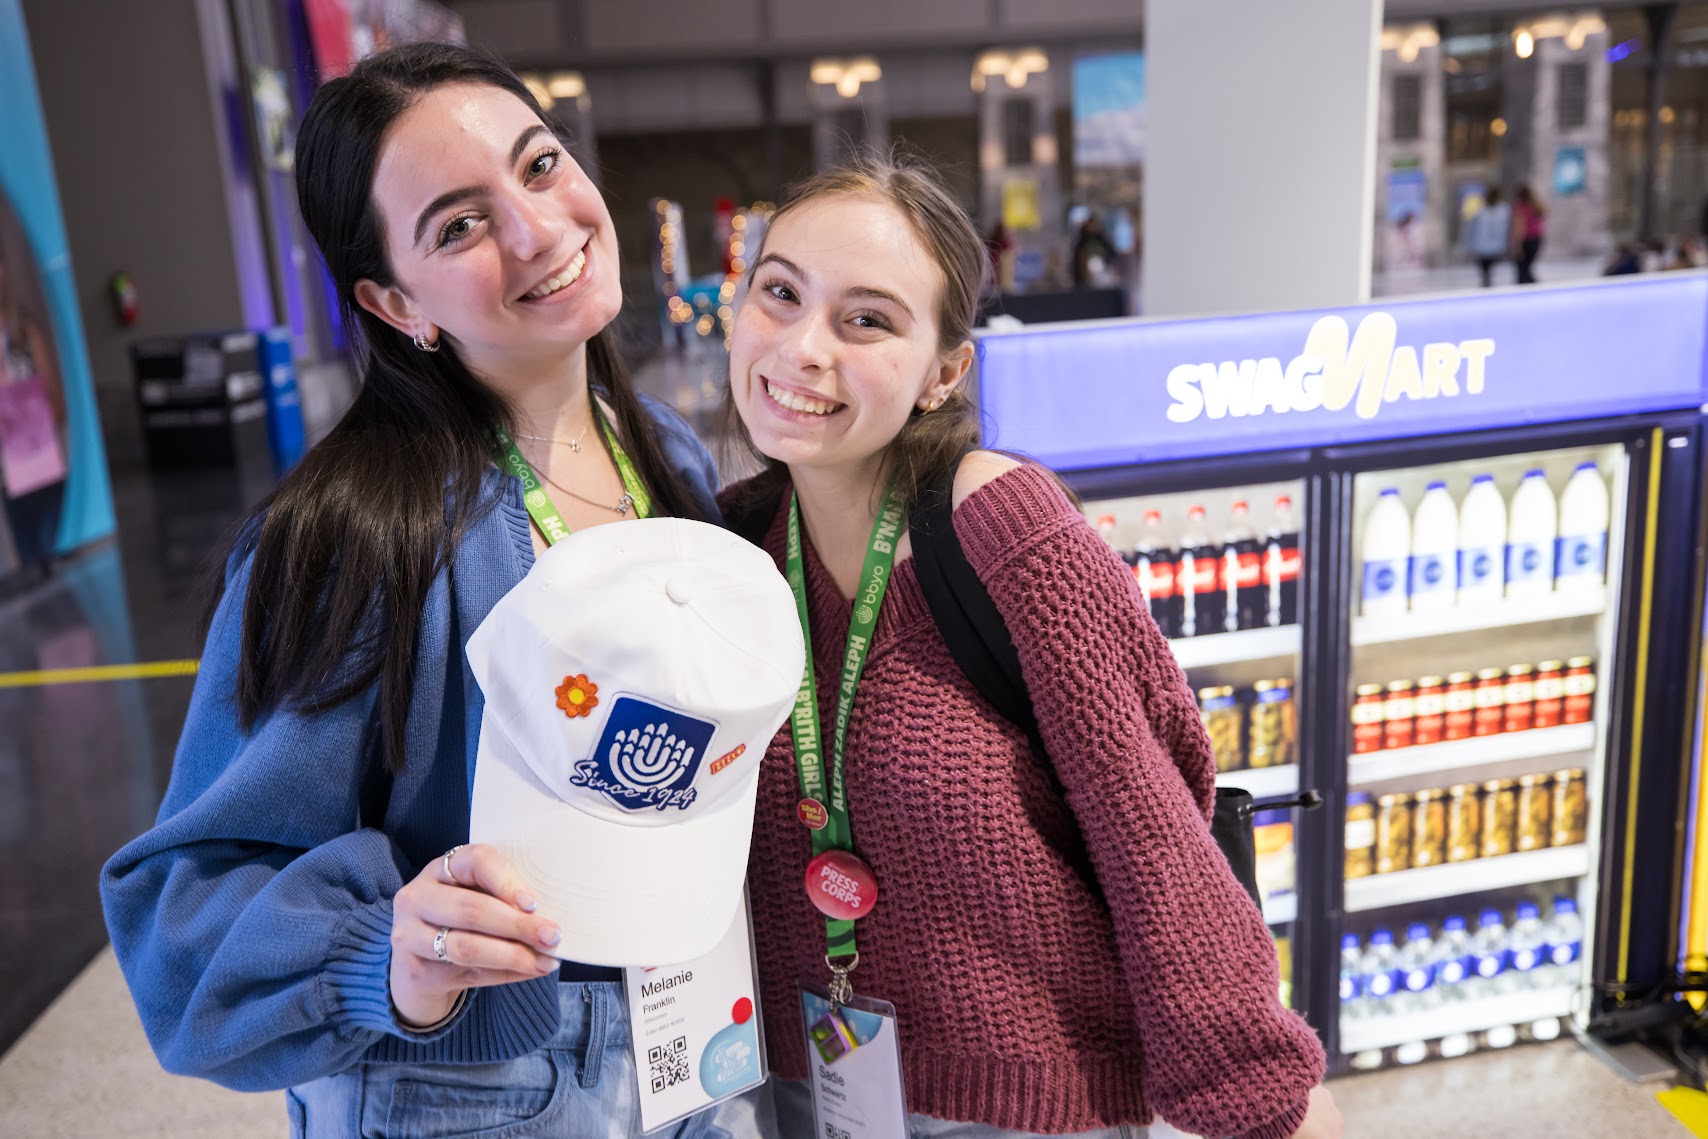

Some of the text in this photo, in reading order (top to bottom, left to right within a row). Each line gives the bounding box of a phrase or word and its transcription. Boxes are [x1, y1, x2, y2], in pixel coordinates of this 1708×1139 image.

[508, 454, 535, 491] bbyo
[864, 565, 884, 604] bbyo
[832, 634, 867, 813] ALEPH ZADIK ALEPH
[570, 761, 697, 811] Since 1924
[820, 866, 859, 894] PRESS
[821, 880, 861, 908] CORPS
[641, 970, 693, 998] Melanie
[642, 995, 676, 1015] Franklin
[819, 1065, 845, 1087] Sadie
